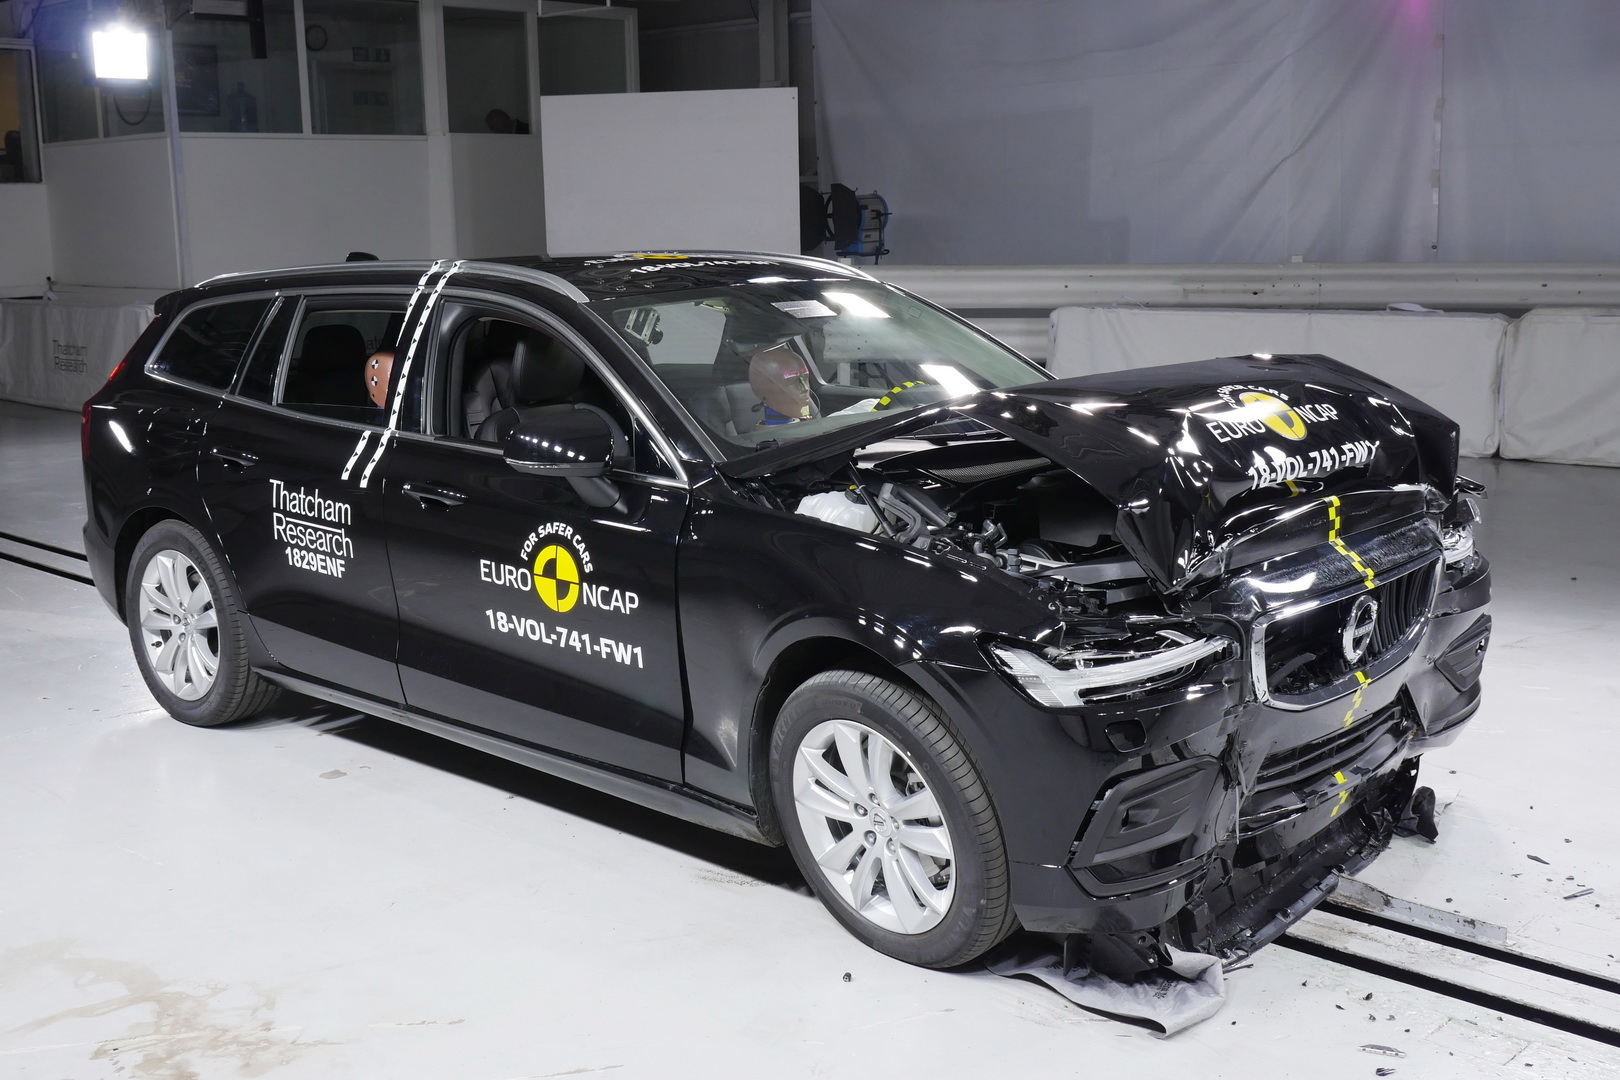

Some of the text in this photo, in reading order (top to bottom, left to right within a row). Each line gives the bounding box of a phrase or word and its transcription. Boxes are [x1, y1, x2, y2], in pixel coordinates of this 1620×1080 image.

[1293, 403, 1338, 424] NCAP
[269, 479, 351, 525] Thatcham
[273, 512, 354, 558] Research
[520, 522, 594, 573] FOR SAFER CARS
[285, 546, 345, 578] 1829ENF
[479, 559, 639, 615] EURO NCAP
[485, 609, 644, 668] 18-VOL-741-FW1
